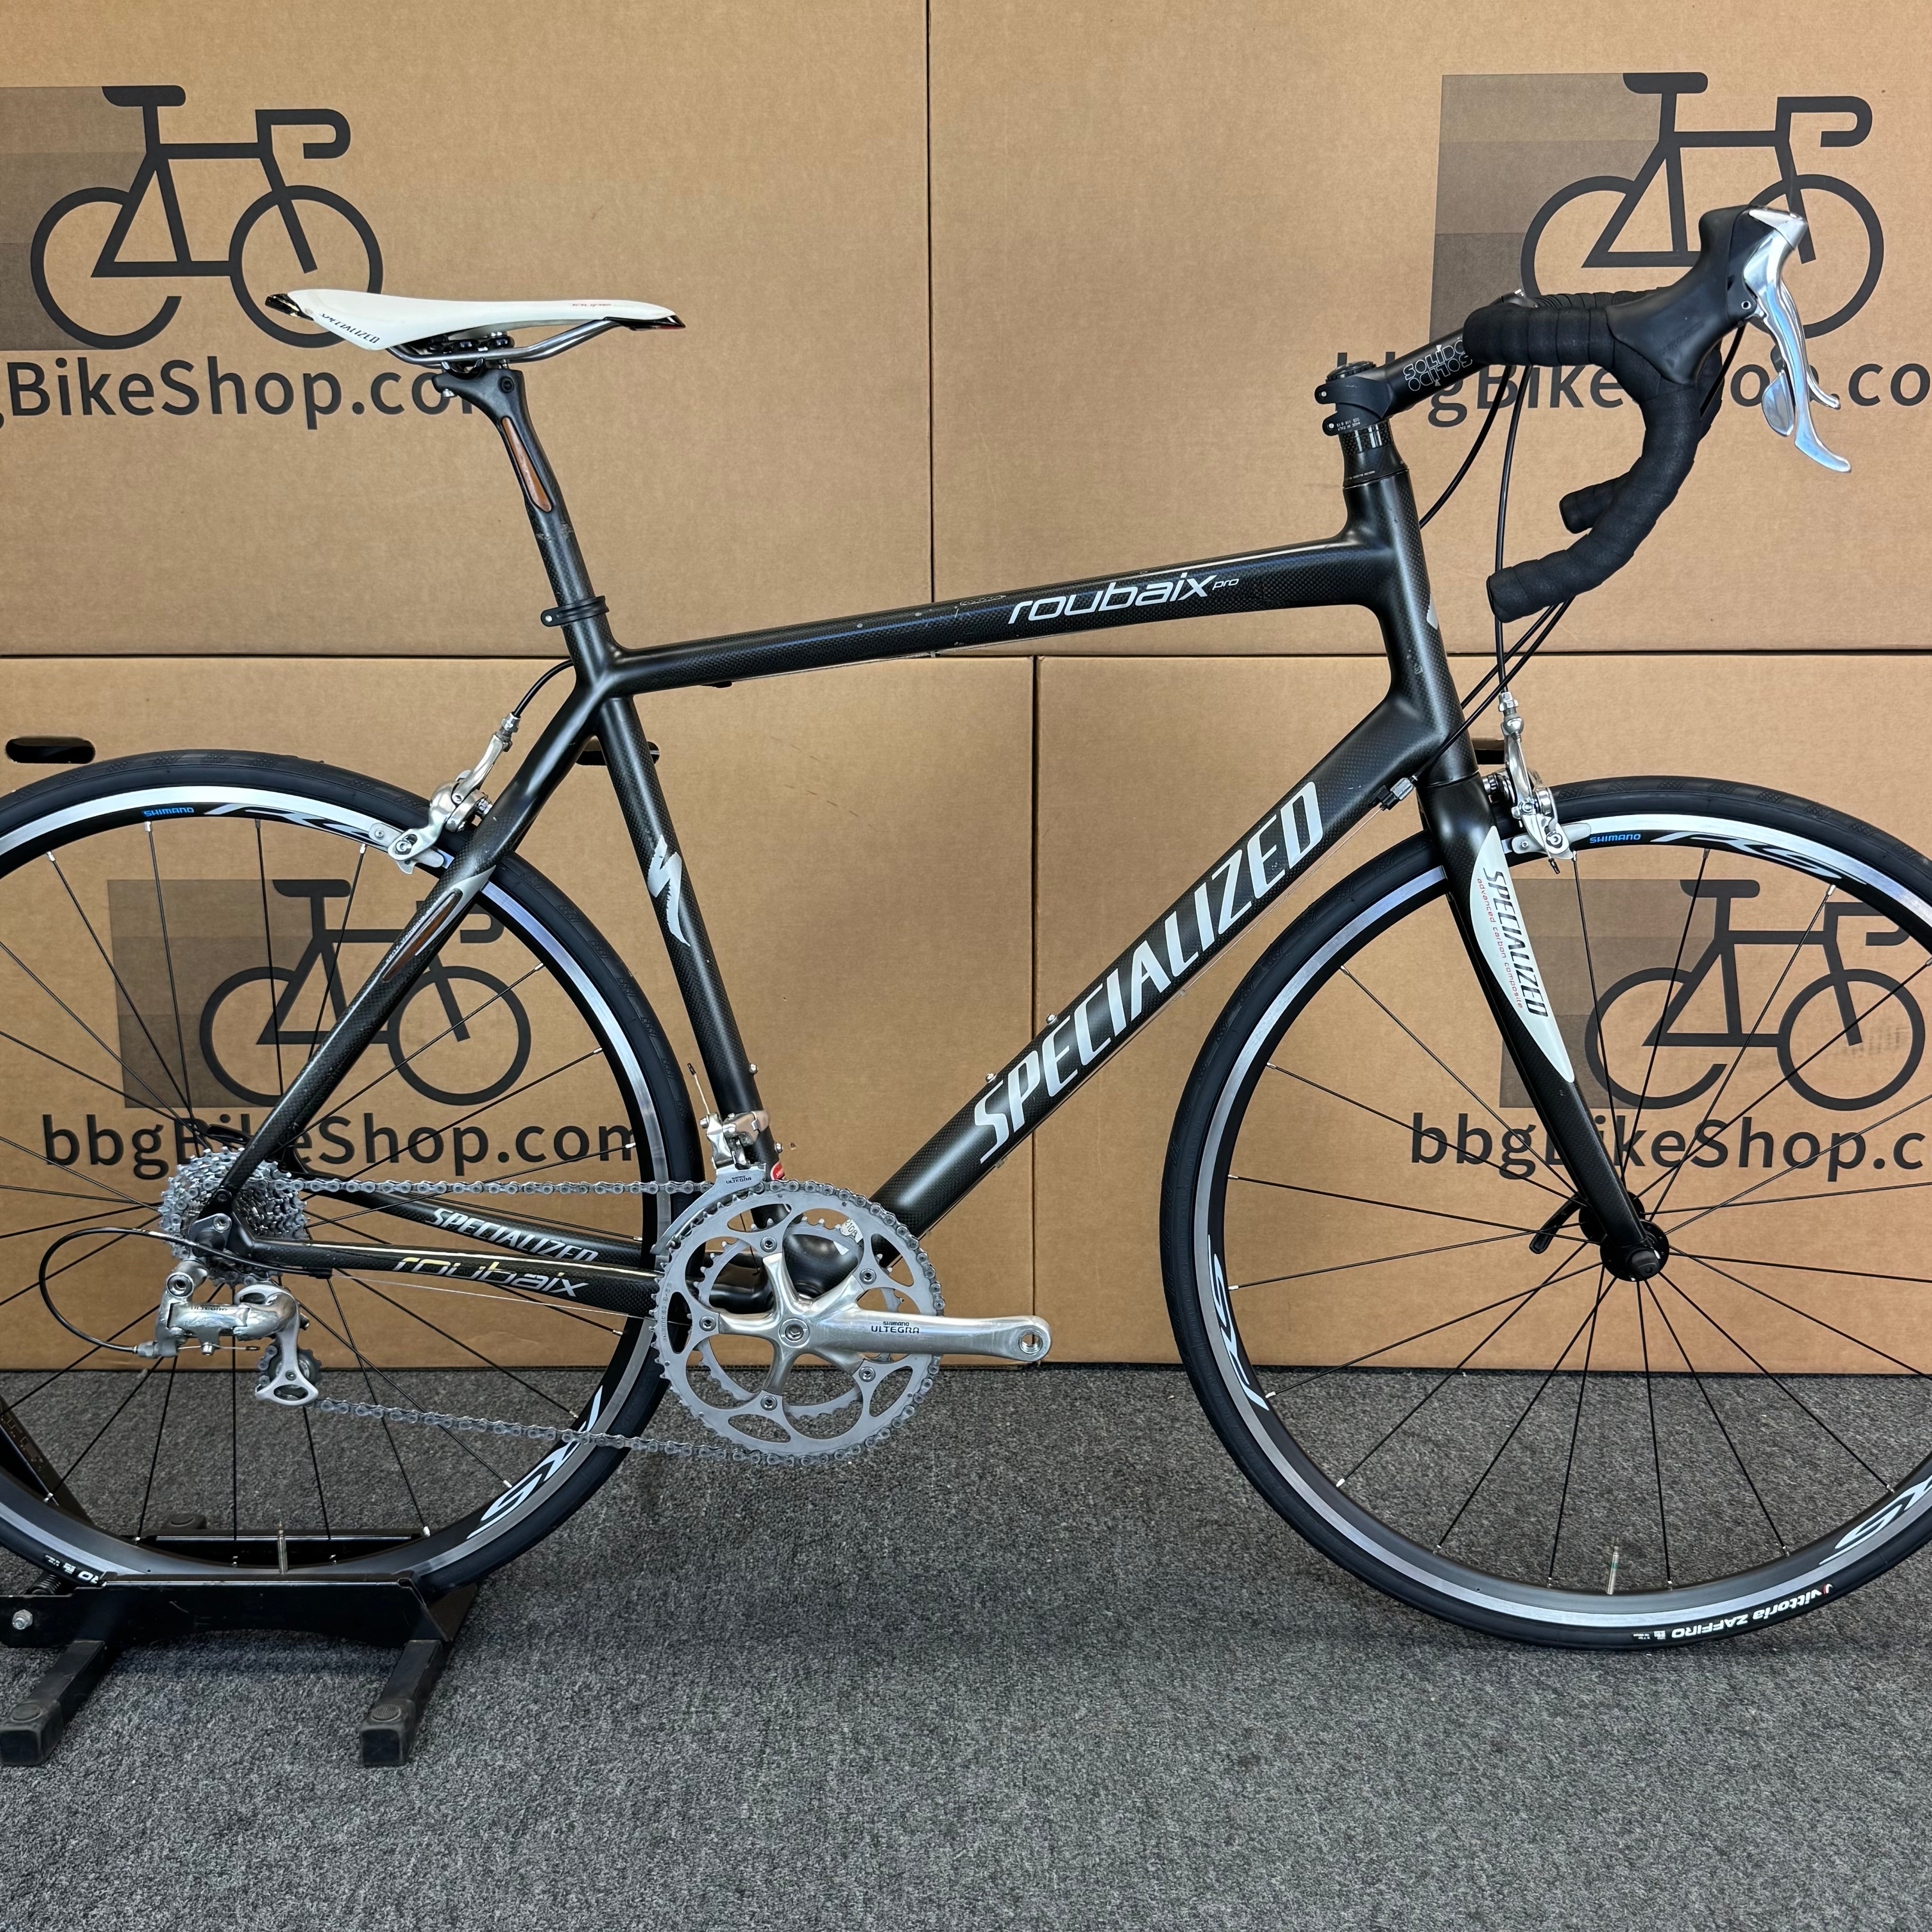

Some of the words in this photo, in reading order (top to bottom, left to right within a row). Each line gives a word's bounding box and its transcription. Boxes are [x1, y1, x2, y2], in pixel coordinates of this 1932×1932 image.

[0, 355, 473, 430] BikeShop.co
[1008, 572, 1217, 625] roubaix
[1212, 578, 1240, 591] pro
[143, 807, 194, 818] SHIMANO
[1589, 833, 1641, 844] SHIMANO
[1477, 878, 1496, 923] advanced
[1493, 926, 1507, 958] carbon
[1504, 962, 1523, 1009] composite
[1483, 867, 1548, 1017] SPECIALIZED
[974, 781, 1324, 1164] SPECIALIZED
[1412, 1112, 1926, 1182] bbgkeShop.c
[425, 1208, 598, 1261] SPECIALIZED
[392, 1256, 589, 1297] roubaix
[871, 1325, 920, 1334] ULTEGRA
[1671, 1614, 1748, 1638] ZAFFIRO
[1753, 1589, 1822, 1620] vittoria
